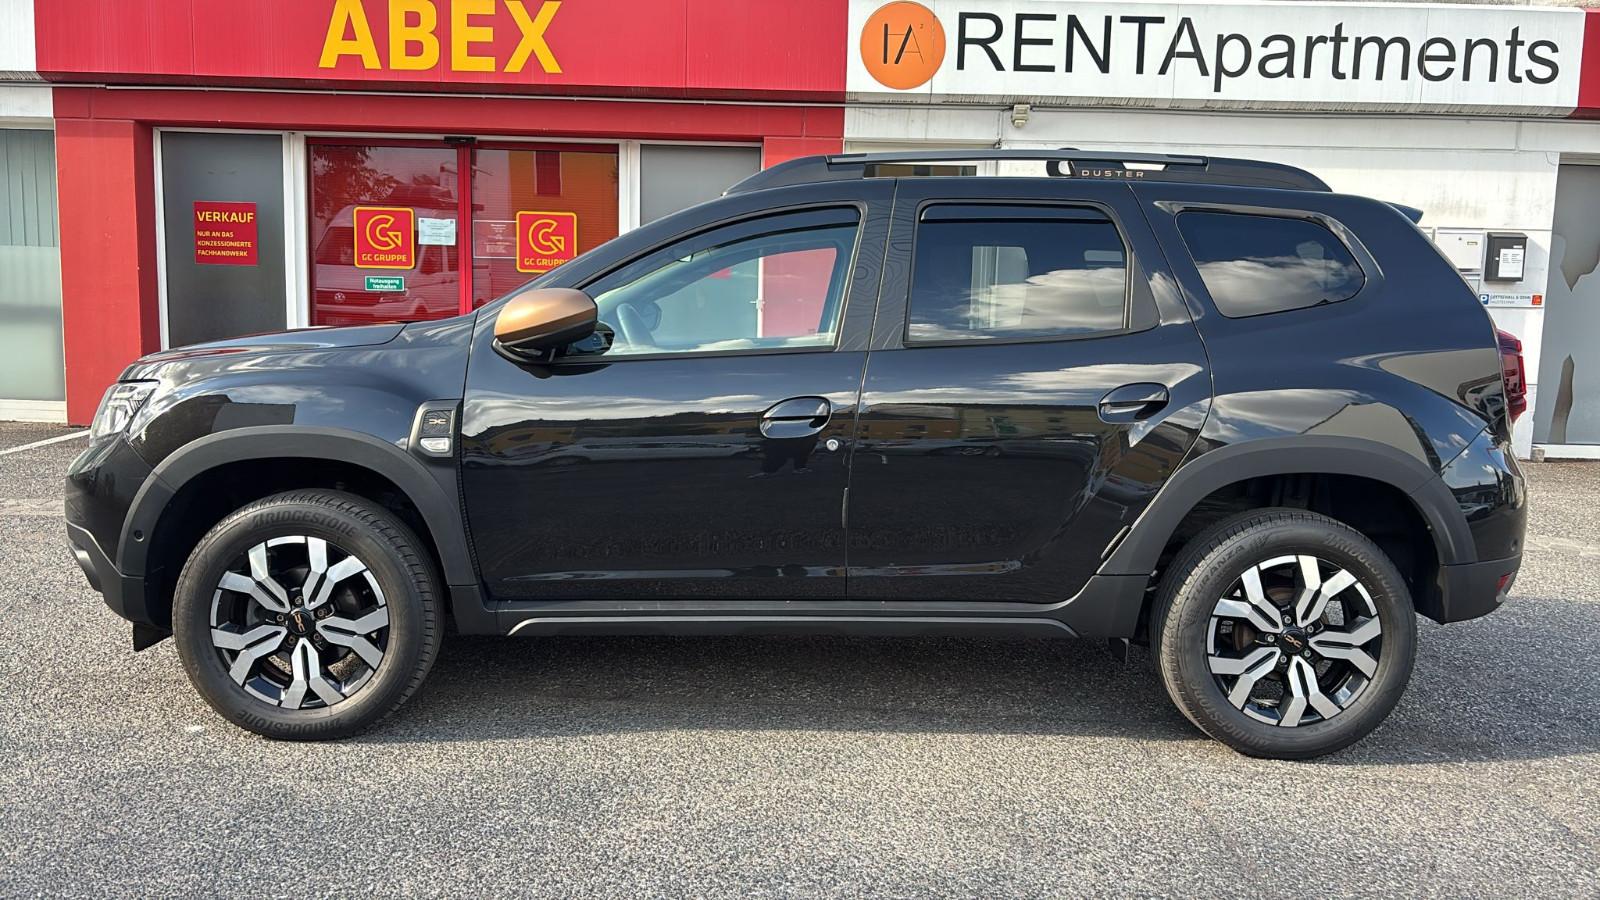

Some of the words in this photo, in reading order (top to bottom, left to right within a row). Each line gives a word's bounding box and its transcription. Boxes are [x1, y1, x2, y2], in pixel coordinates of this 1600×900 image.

[318, 0, 563, 73] ABEX
[956, 12, 1561, 93] RENTApartments
[1081, 169, 1144, 178] DUSTER
[196, 211, 254, 223] VERKAUF
[197, 240, 252, 248] KONZESSIONIERTE
[197, 249, 248, 257] FACHHANDWERK
[361, 253, 373, 261] GC
[374, 253, 407, 262] GRUPPE
[524, 258, 536, 266] GC
[536, 258, 569, 267] GRUPP
[253, 510, 357, 536] BRIDGESTONE
[1191, 545, 1246, 601] TURANZA
[238, 709, 342, 733] BRIDGESTONE
